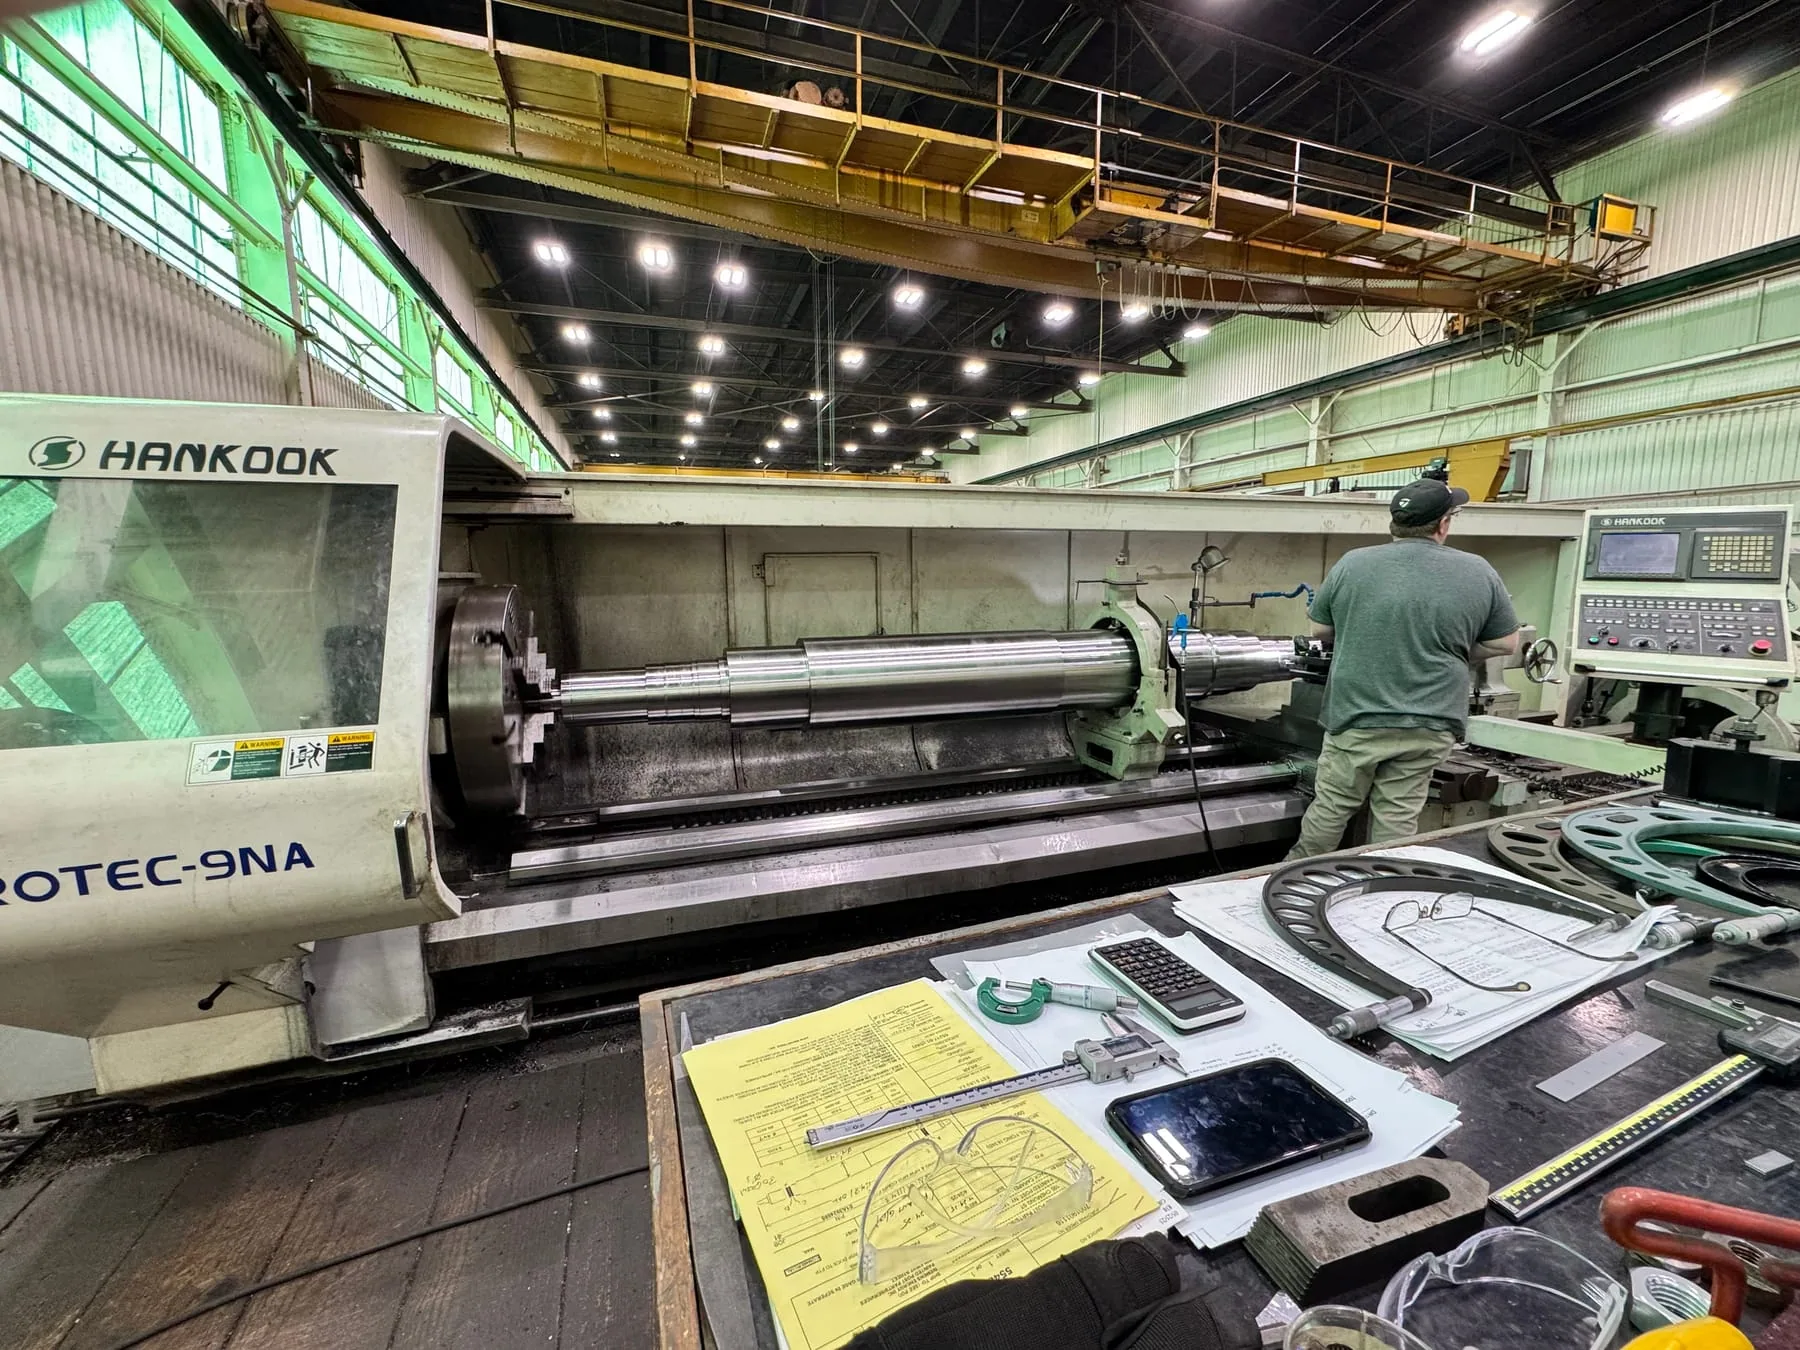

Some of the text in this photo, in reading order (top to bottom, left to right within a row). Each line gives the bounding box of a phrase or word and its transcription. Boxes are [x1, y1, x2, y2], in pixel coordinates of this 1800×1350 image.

[99, 439, 339, 477] HANKOOK
[1614, 517, 1666, 526] HANKOOK
[341, 734, 371, 742] WARNING
[0, 841, 315, 906] OTEC-9NA
